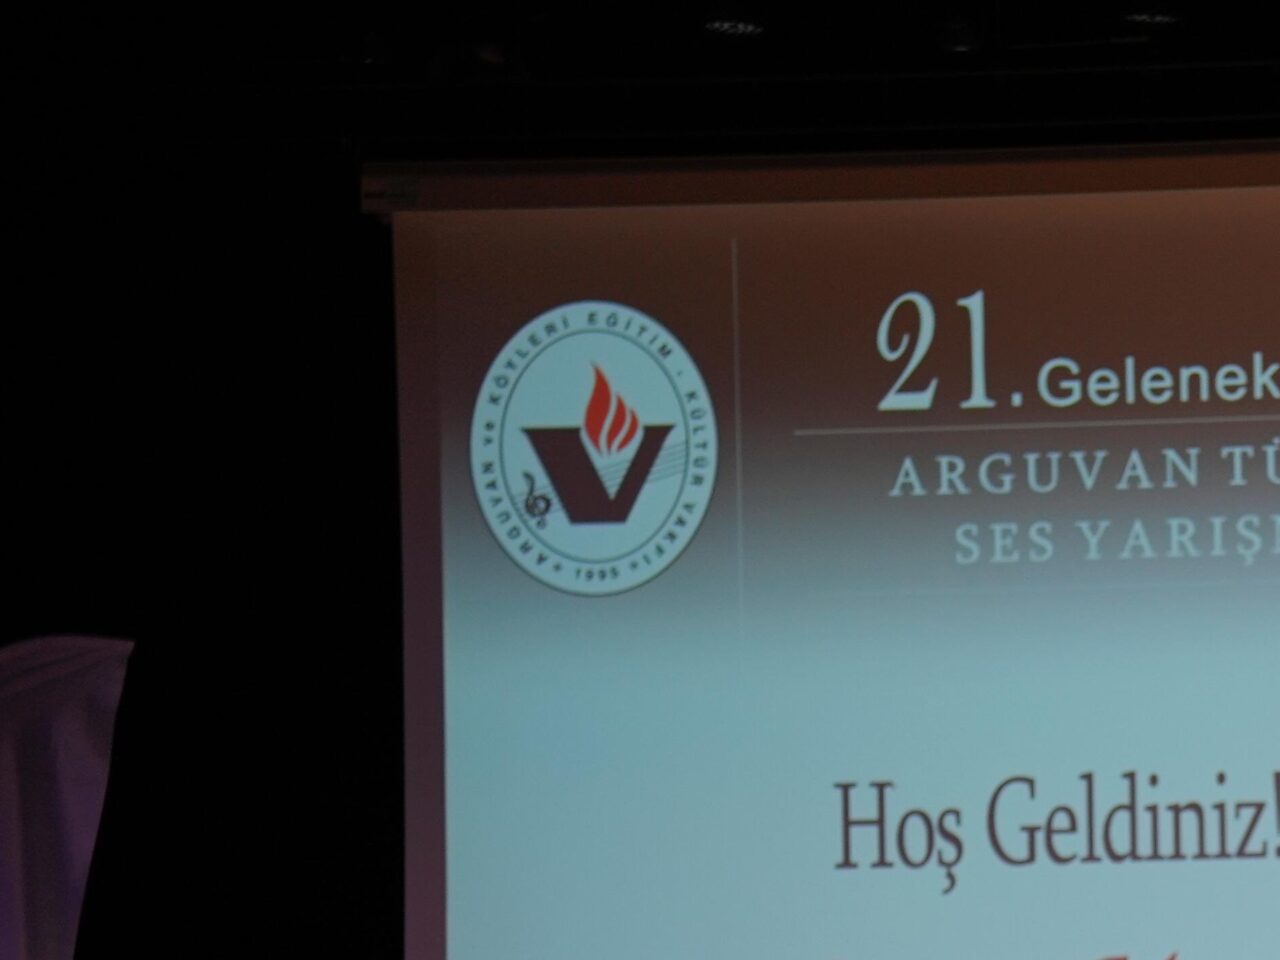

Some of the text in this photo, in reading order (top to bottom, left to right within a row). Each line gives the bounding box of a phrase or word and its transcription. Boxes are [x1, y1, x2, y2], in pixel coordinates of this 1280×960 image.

[876, 289, 1024, 411] 21.
[482, 421, 495, 446] ve
[889, 446, 1202, 497] ARGUVAN
[955, 520, 1055, 565] SES
[833, 780, 965, 895] Hoş
